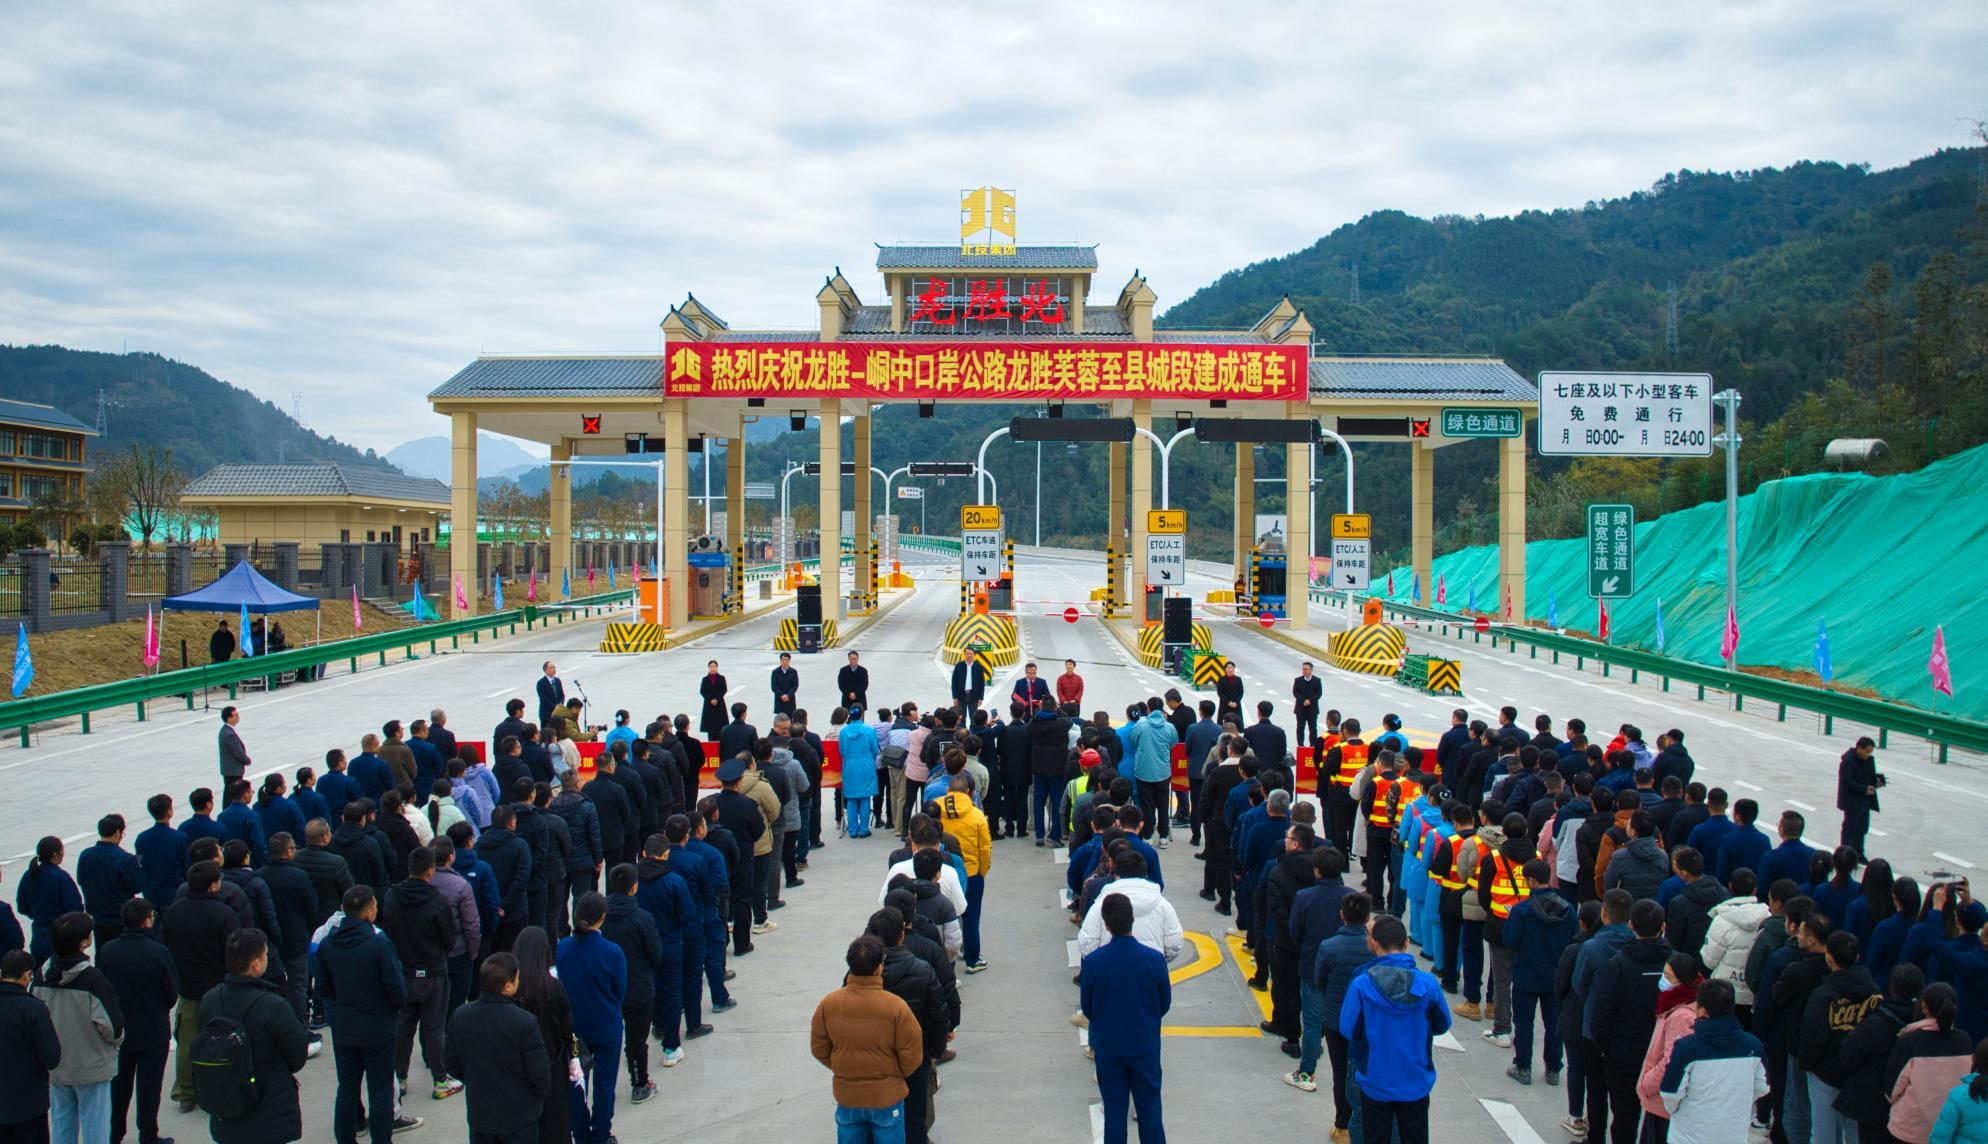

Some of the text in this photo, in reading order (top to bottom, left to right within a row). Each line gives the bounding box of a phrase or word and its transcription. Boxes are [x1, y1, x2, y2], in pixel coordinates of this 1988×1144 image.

[961, 244, 1016, 256] 北投集团
[909, 277, 1064, 324] 龙胜北
[1553, 383, 1699, 399] 七座及以下小型客车
[1447, 414, 1516, 431] 绿色通道
[966, 536, 996, 545] ETC车道
[1150, 540, 1180, 549] ETC/人工
[1594, 511, 1609, 570] 超宽车道
[1613, 511, 1628, 570] 绿色通道
[1336, 545, 1366, 553] ETC/人工
[967, 550, 996, 559] 保持车距
[1151, 555, 1181, 564] 保持车距
[1336, 559, 1366, 568] 保持车距
